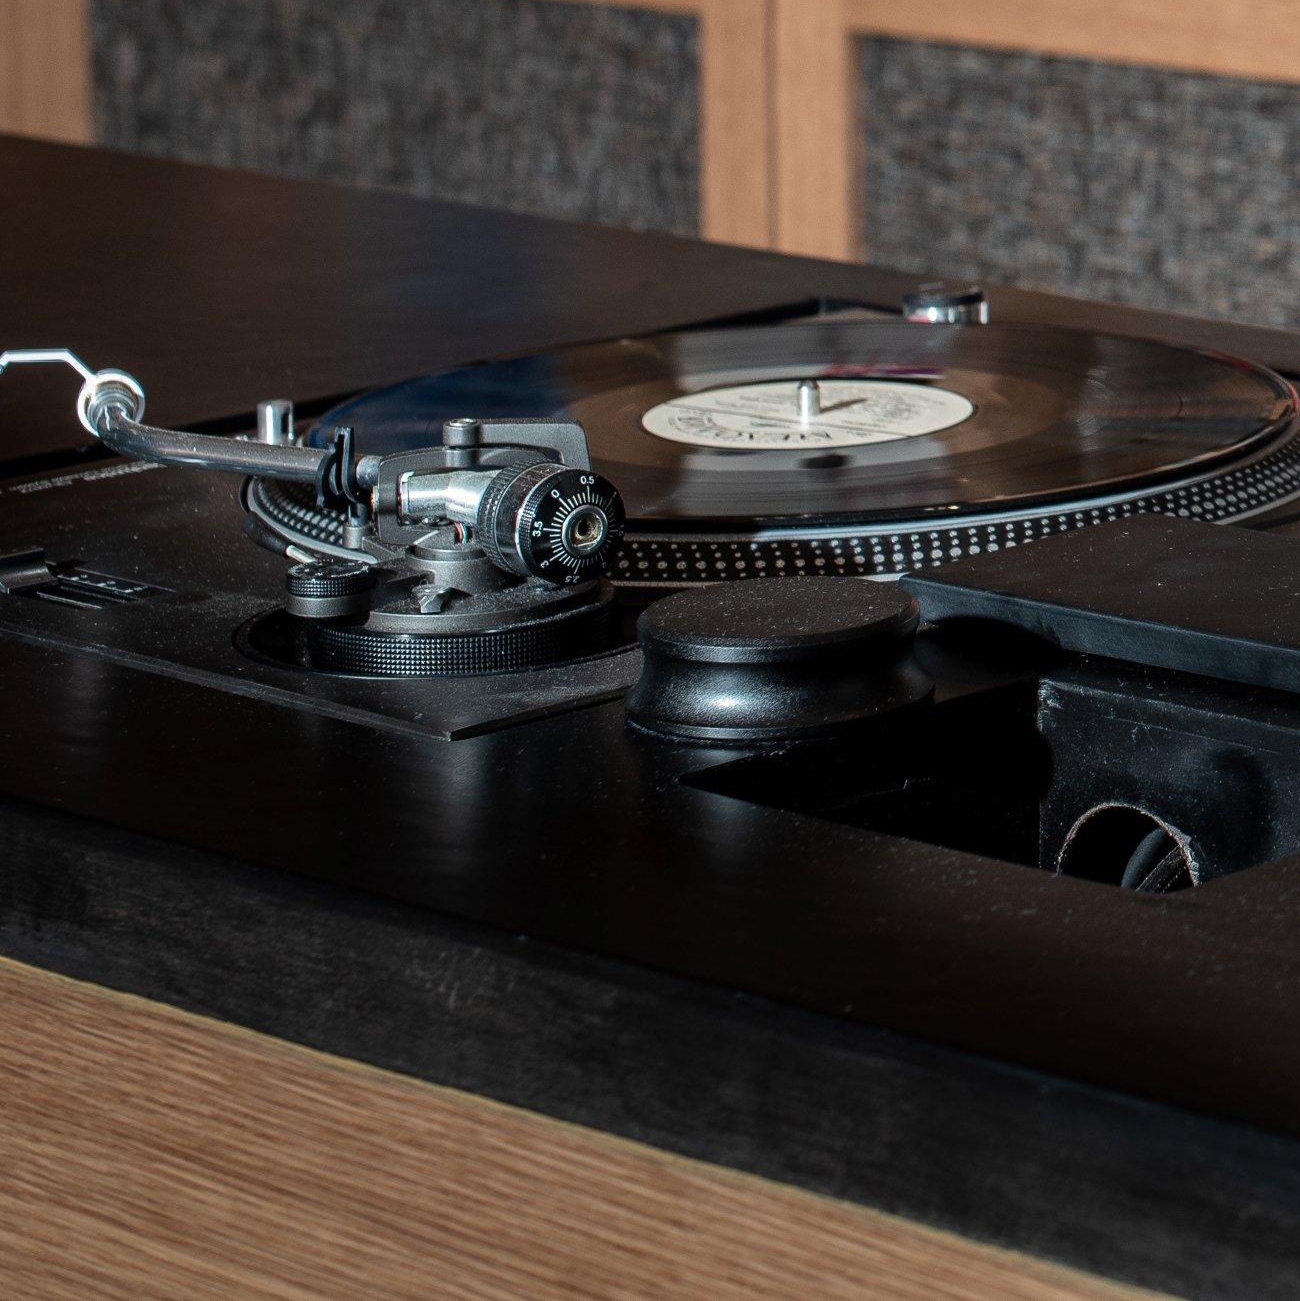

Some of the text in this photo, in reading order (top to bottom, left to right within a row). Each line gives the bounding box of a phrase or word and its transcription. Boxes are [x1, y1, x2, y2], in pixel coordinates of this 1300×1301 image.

[580, 476, 595, 485] 0.5
[550, 489, 560, 498] 0
[532, 521, 544, 537] 3.5
